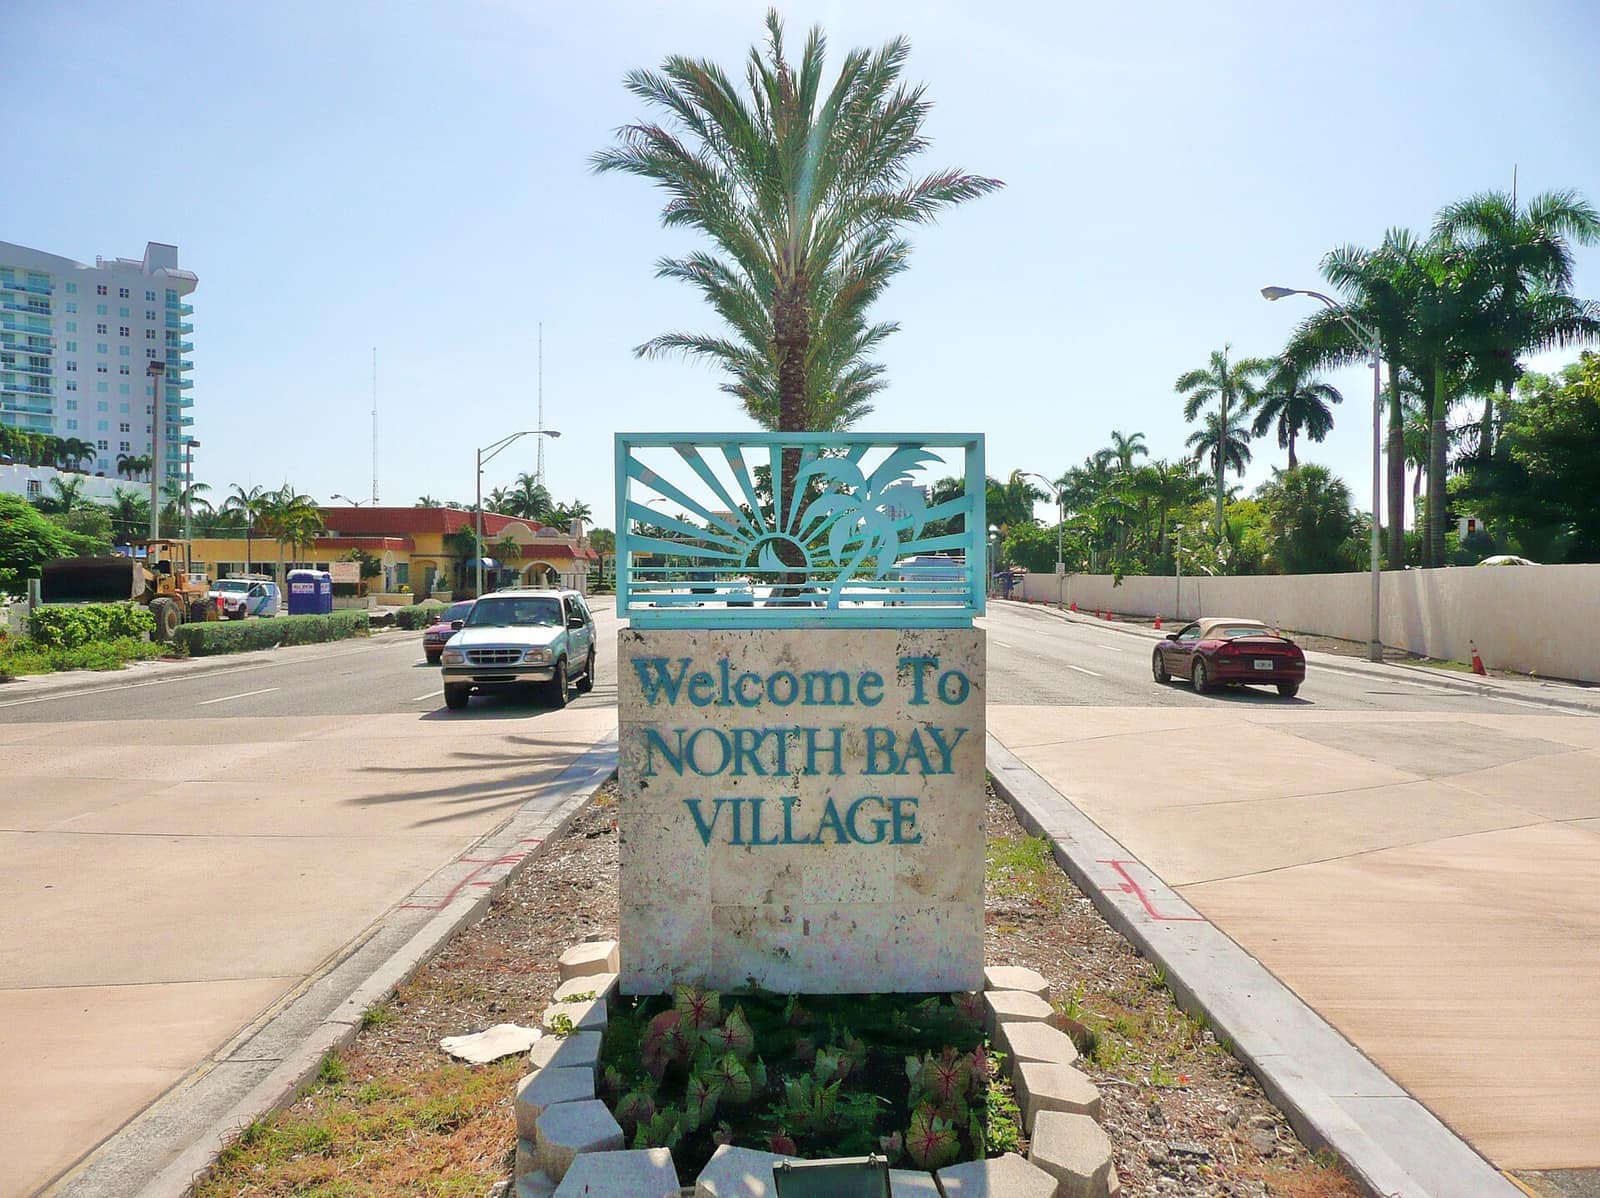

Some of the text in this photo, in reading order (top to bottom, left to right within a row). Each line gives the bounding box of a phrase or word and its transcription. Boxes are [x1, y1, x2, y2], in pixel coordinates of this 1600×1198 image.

[630, 656, 970, 707] Welcome To
[642, 726, 969, 777] NORTH BAY
[683, 796, 923, 848] VILLAGE
